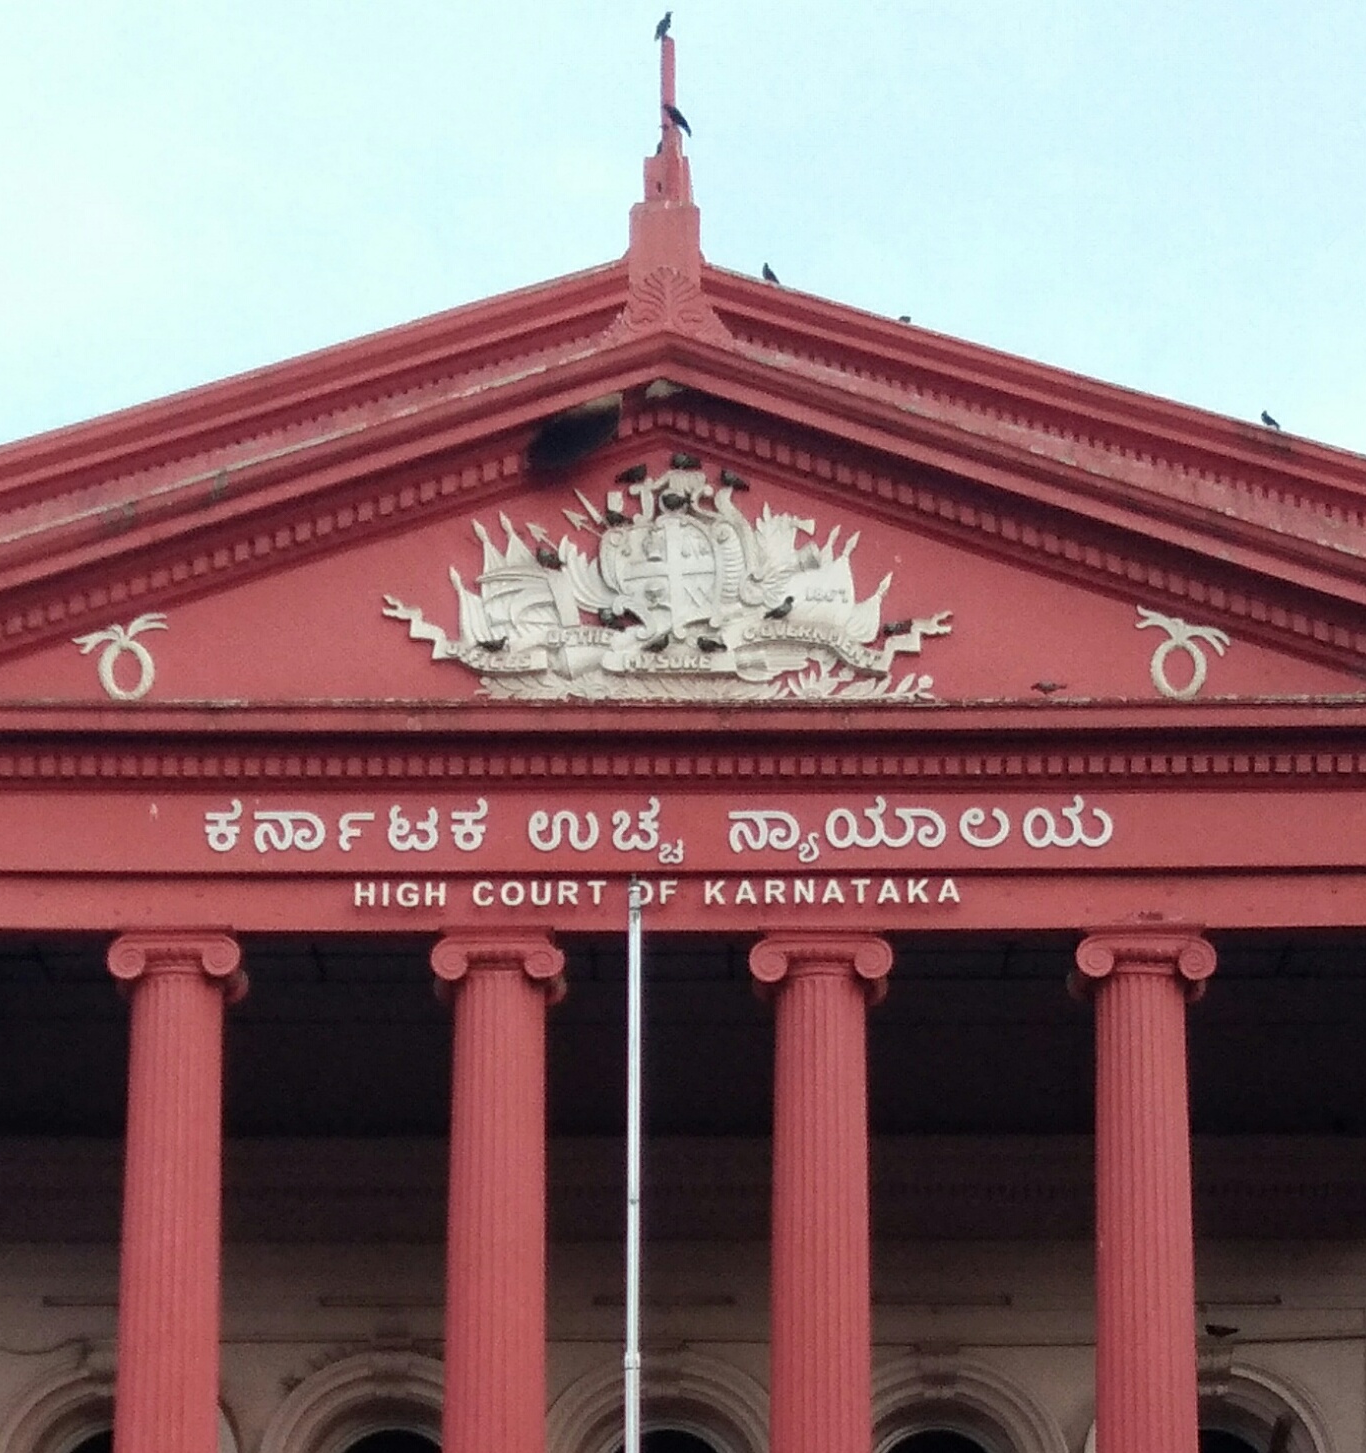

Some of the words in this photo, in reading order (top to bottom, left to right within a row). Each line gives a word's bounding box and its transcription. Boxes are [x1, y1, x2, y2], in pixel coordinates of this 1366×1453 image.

[622, 654, 712, 671] MYSORE
[204, 798, 489, 854] ಕರ್ನಾಟಕ
[728, 795, 1114, 864] ನ್ಯಾಯಾಲಯ
[353, 881, 447, 907] HIGH
[472, 880, 607, 906] COURT
[633, 880, 677, 906] OF
[703, 878, 961, 905] KARNATAKA
